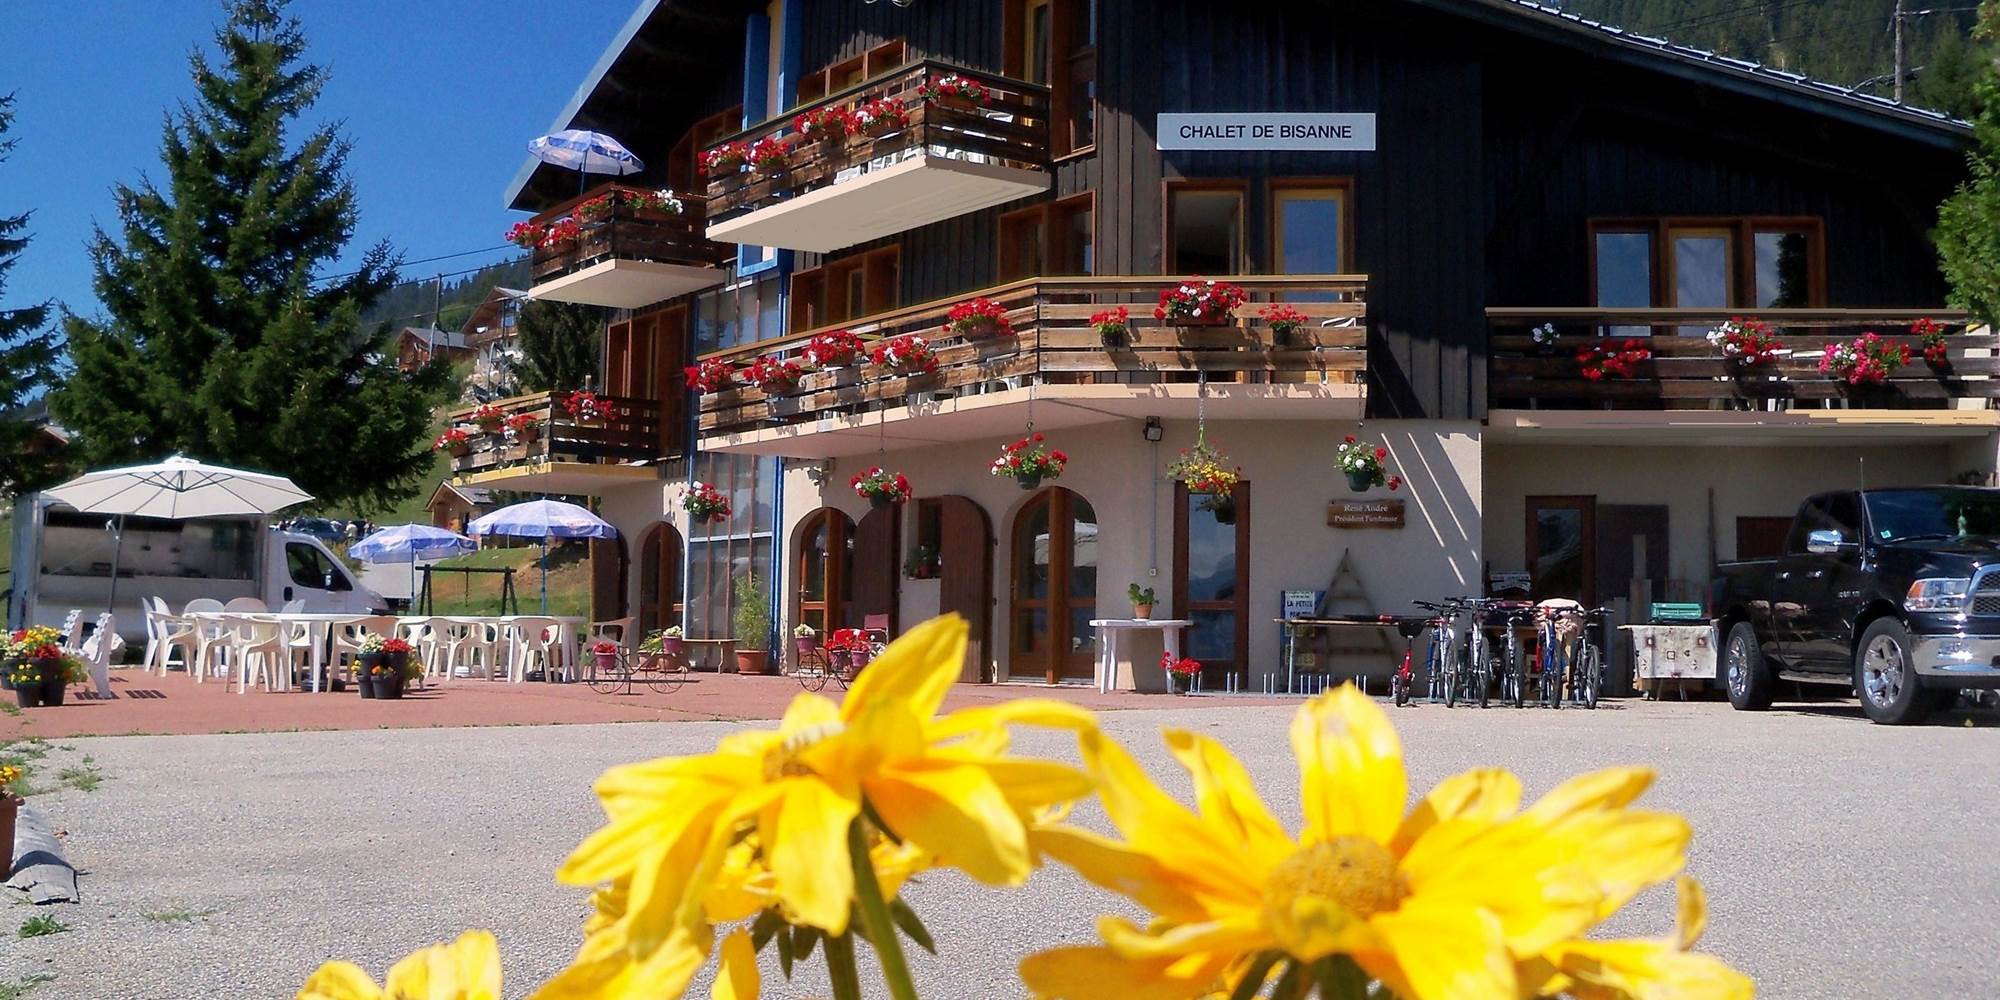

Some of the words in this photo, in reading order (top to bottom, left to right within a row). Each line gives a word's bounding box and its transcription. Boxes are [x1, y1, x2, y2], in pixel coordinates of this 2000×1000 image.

[1179, 125, 1246, 139] CHALET
[1252, 125, 1274, 138] DE
[1280, 125, 1352, 138] BISANNE
